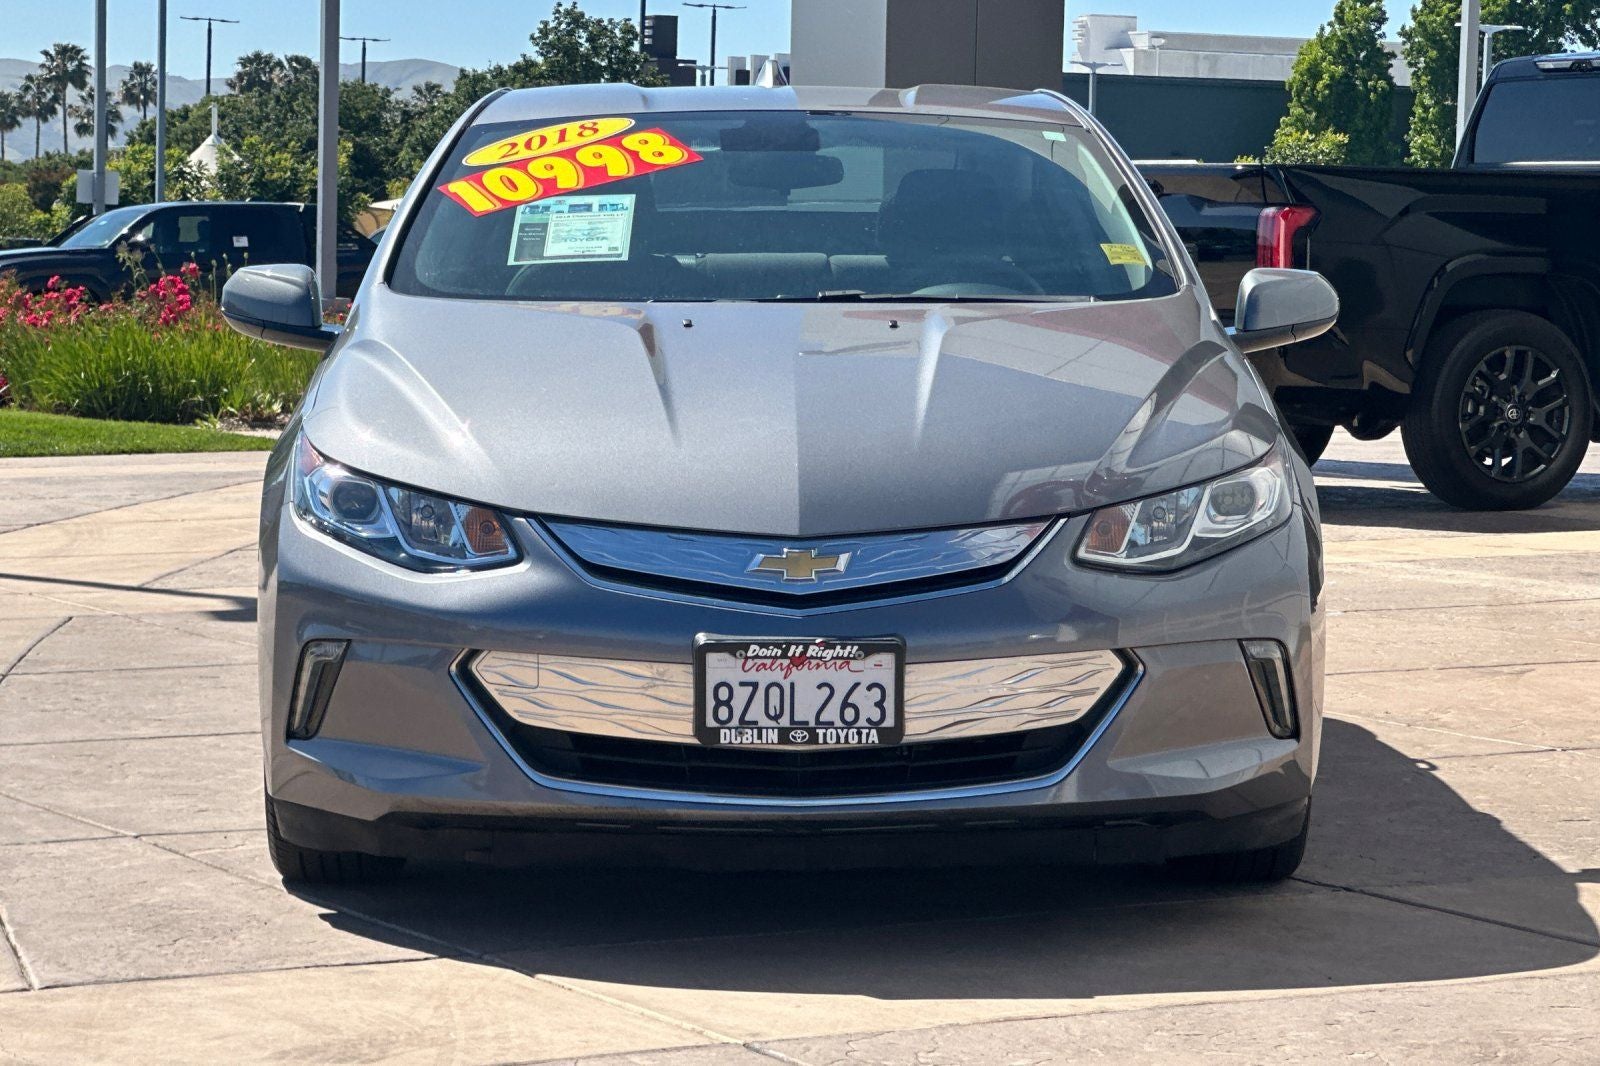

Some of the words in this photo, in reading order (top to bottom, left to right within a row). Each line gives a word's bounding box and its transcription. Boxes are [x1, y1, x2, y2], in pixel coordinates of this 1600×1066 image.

[497, 121, 600, 160] 2018
[447, 132, 688, 213] 10998
[746, 644, 786, 658] Doin'
[787, 644, 804, 658] It
[806, 645, 858, 661] Right!
[712, 681, 887, 727] 8ZQL263
[719, 728, 779, 744] DUBLIN
[816, 728, 879, 744] TOYOTA
